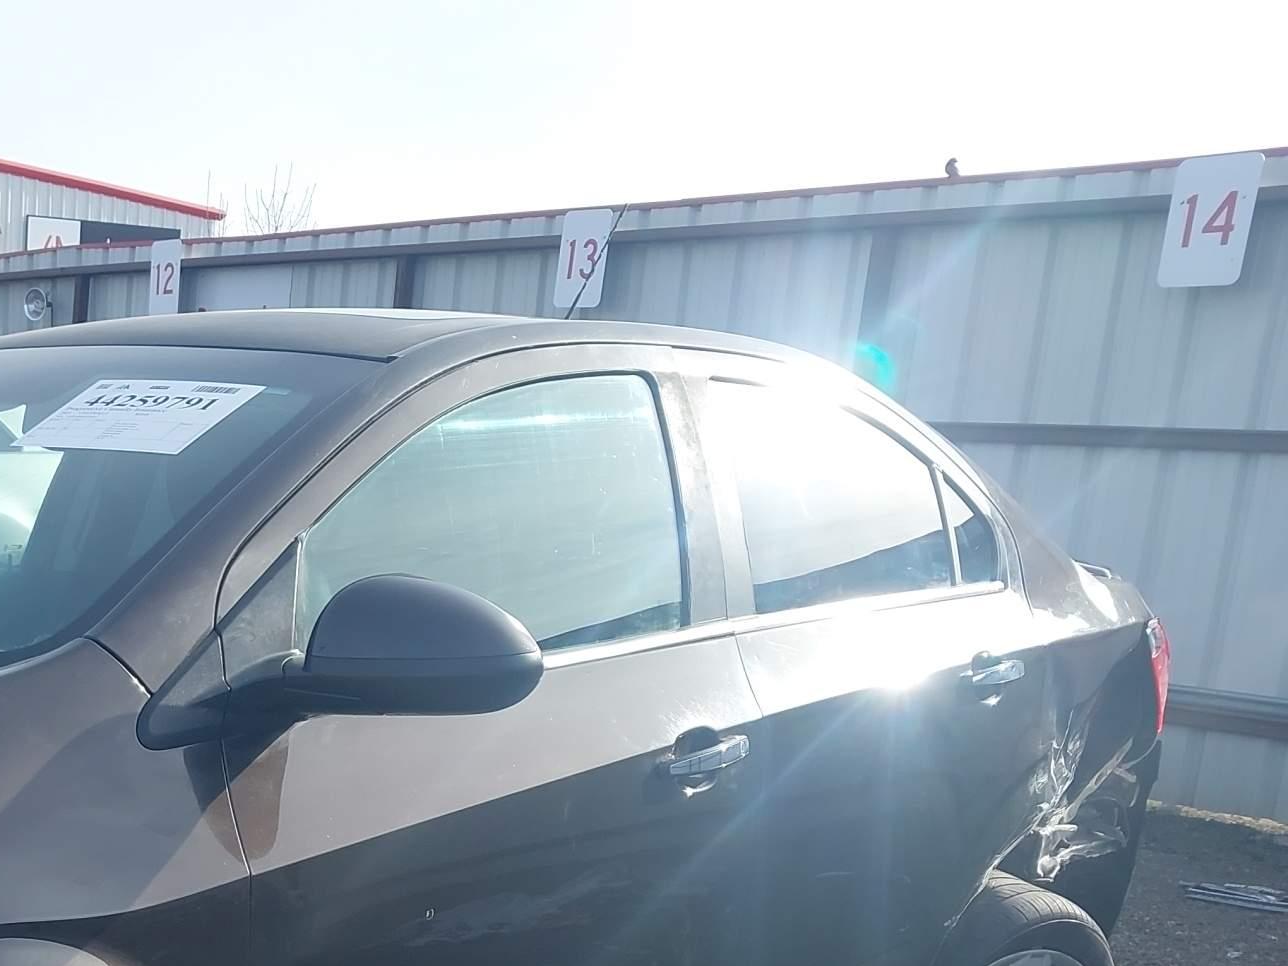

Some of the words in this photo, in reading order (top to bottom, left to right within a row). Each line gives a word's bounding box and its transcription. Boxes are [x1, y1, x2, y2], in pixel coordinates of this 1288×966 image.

[1180, 192, 1238, 248] 14
[567, 239, 598, 280] 13
[156, 262, 174, 295] 12
[85, 395, 219, 410] 44259791
